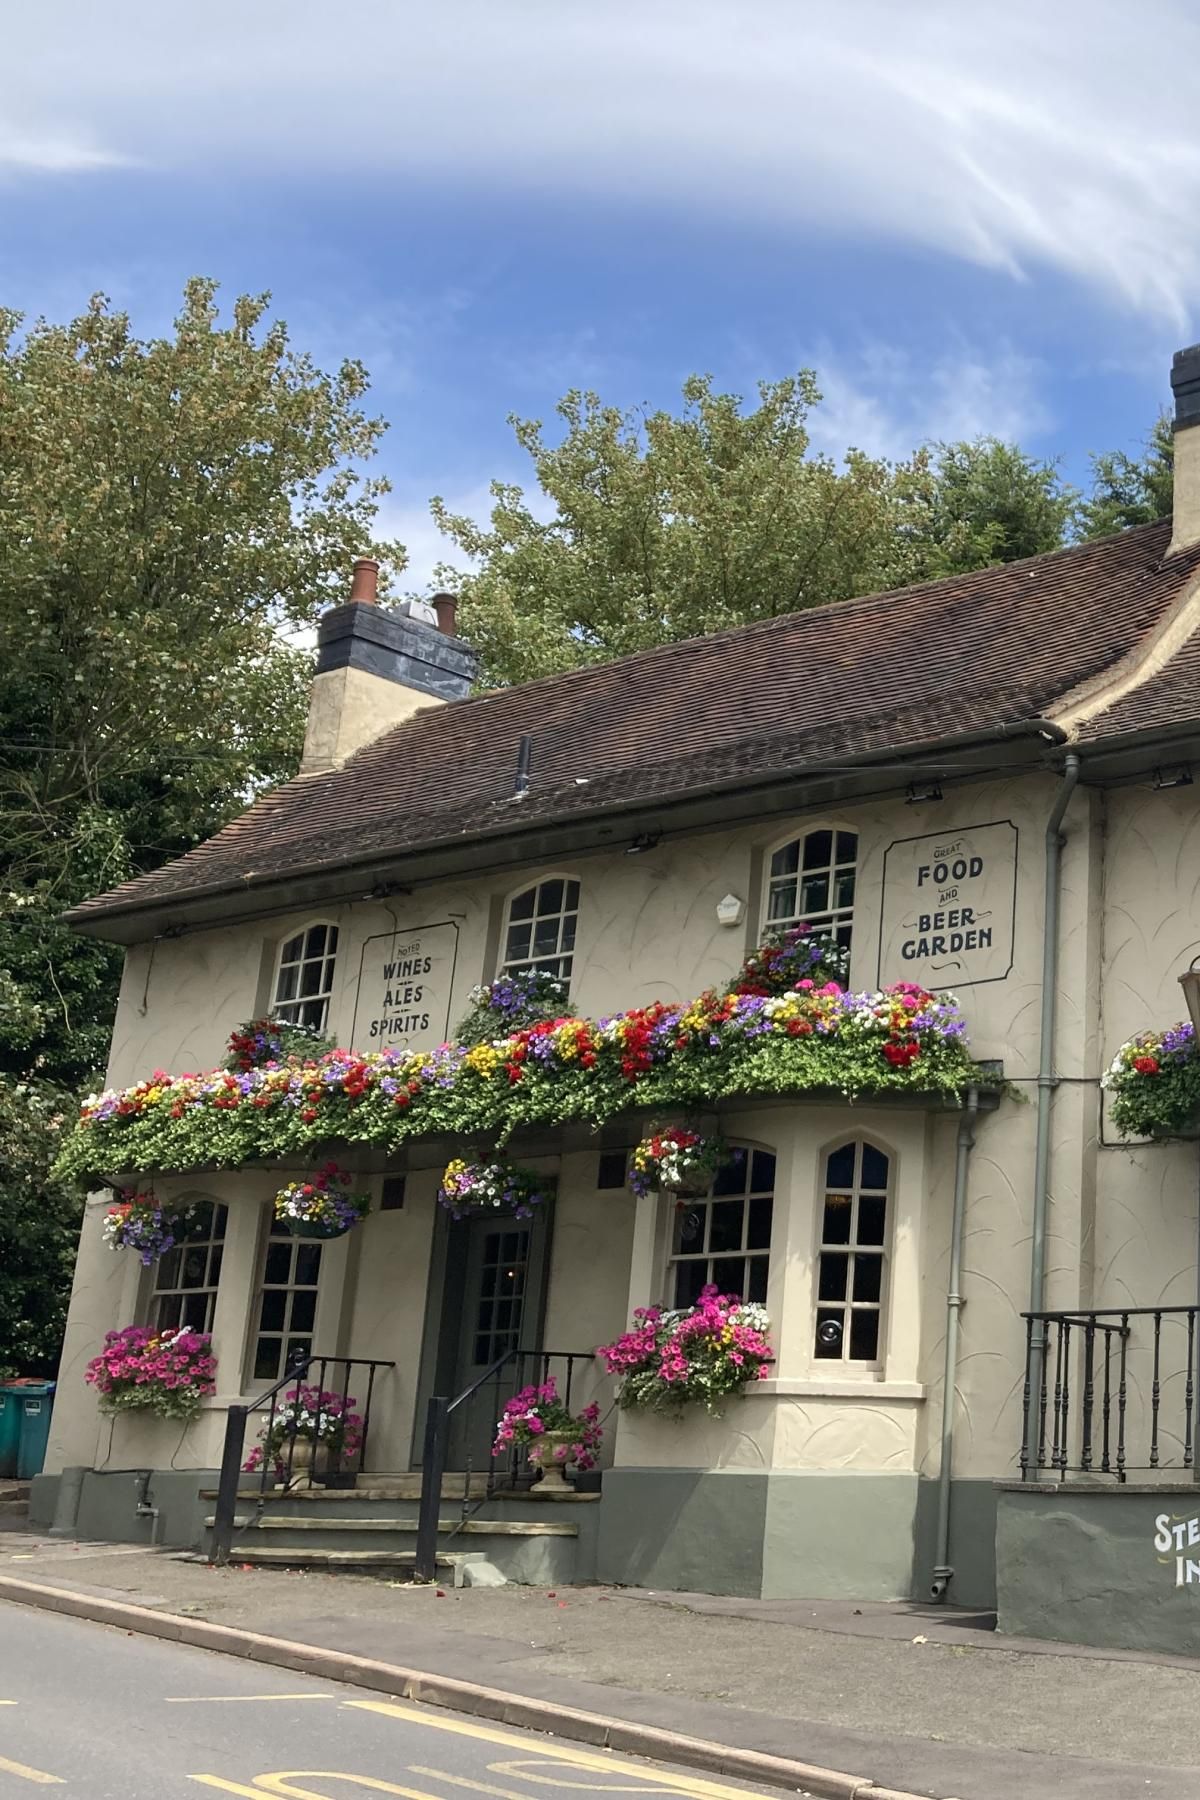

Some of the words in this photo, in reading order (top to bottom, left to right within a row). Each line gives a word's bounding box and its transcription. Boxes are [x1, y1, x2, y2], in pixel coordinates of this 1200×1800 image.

[933, 842, 961, 859] GREAT
[917, 857, 984, 887] FOOD
[939, 889, 958, 904] AND
[918, 907, 977, 933] BEER
[901, 927, 992, 960] GARDEN
[383, 956, 432, 980] WINES
[383, 985, 423, 1008] ALES
[369, 1013, 430, 1037] SPIRITS
